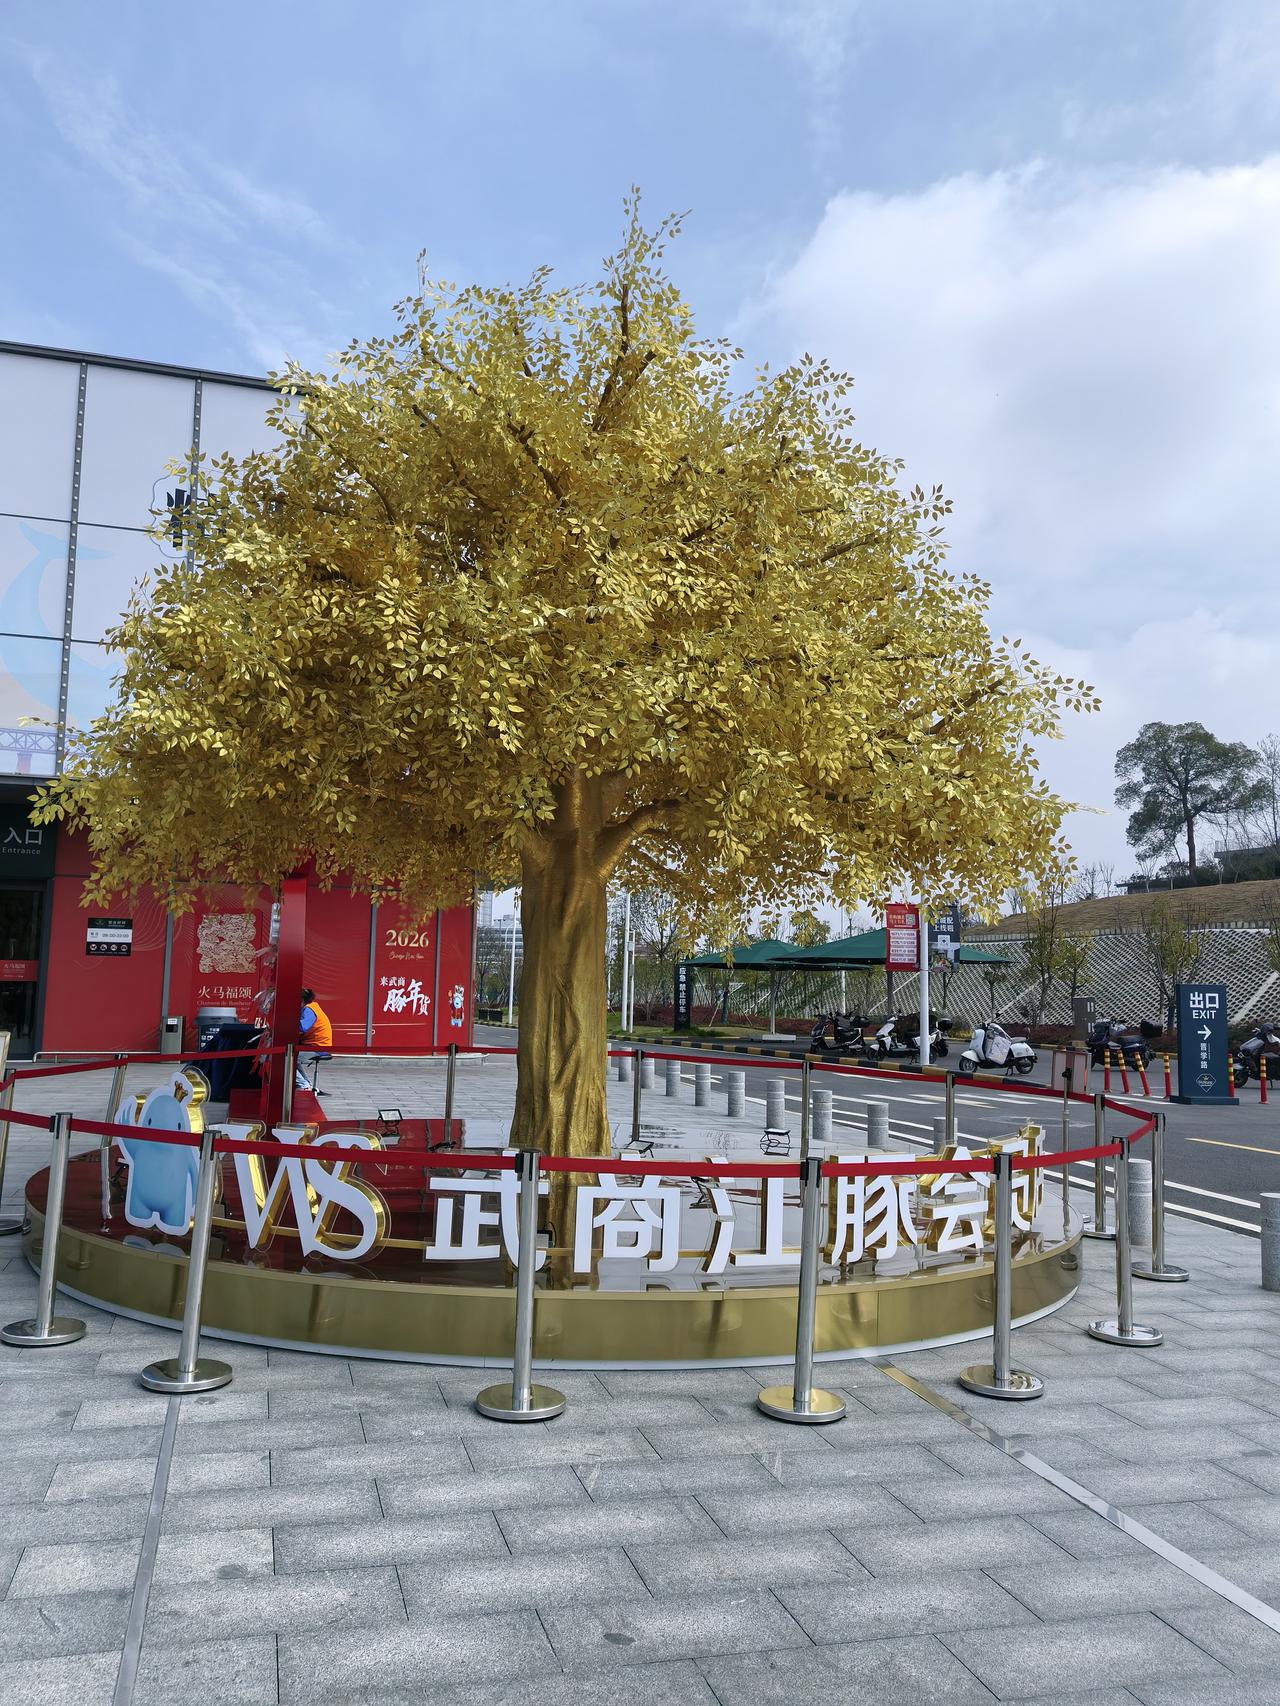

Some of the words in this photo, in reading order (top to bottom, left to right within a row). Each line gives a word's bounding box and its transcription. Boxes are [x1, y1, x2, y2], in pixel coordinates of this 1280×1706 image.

[3, 827, 43, 845] 入口
[2, 846, 41, 855] Entrance
[385, 929, 430, 948] 2026
[380, 976, 406, 987] 来武商
[197, 985, 252, 999] 火马福颂
[1189, 991, 1220, 1009] 出口
[1192, 1010, 1217, 1020] EXIT
